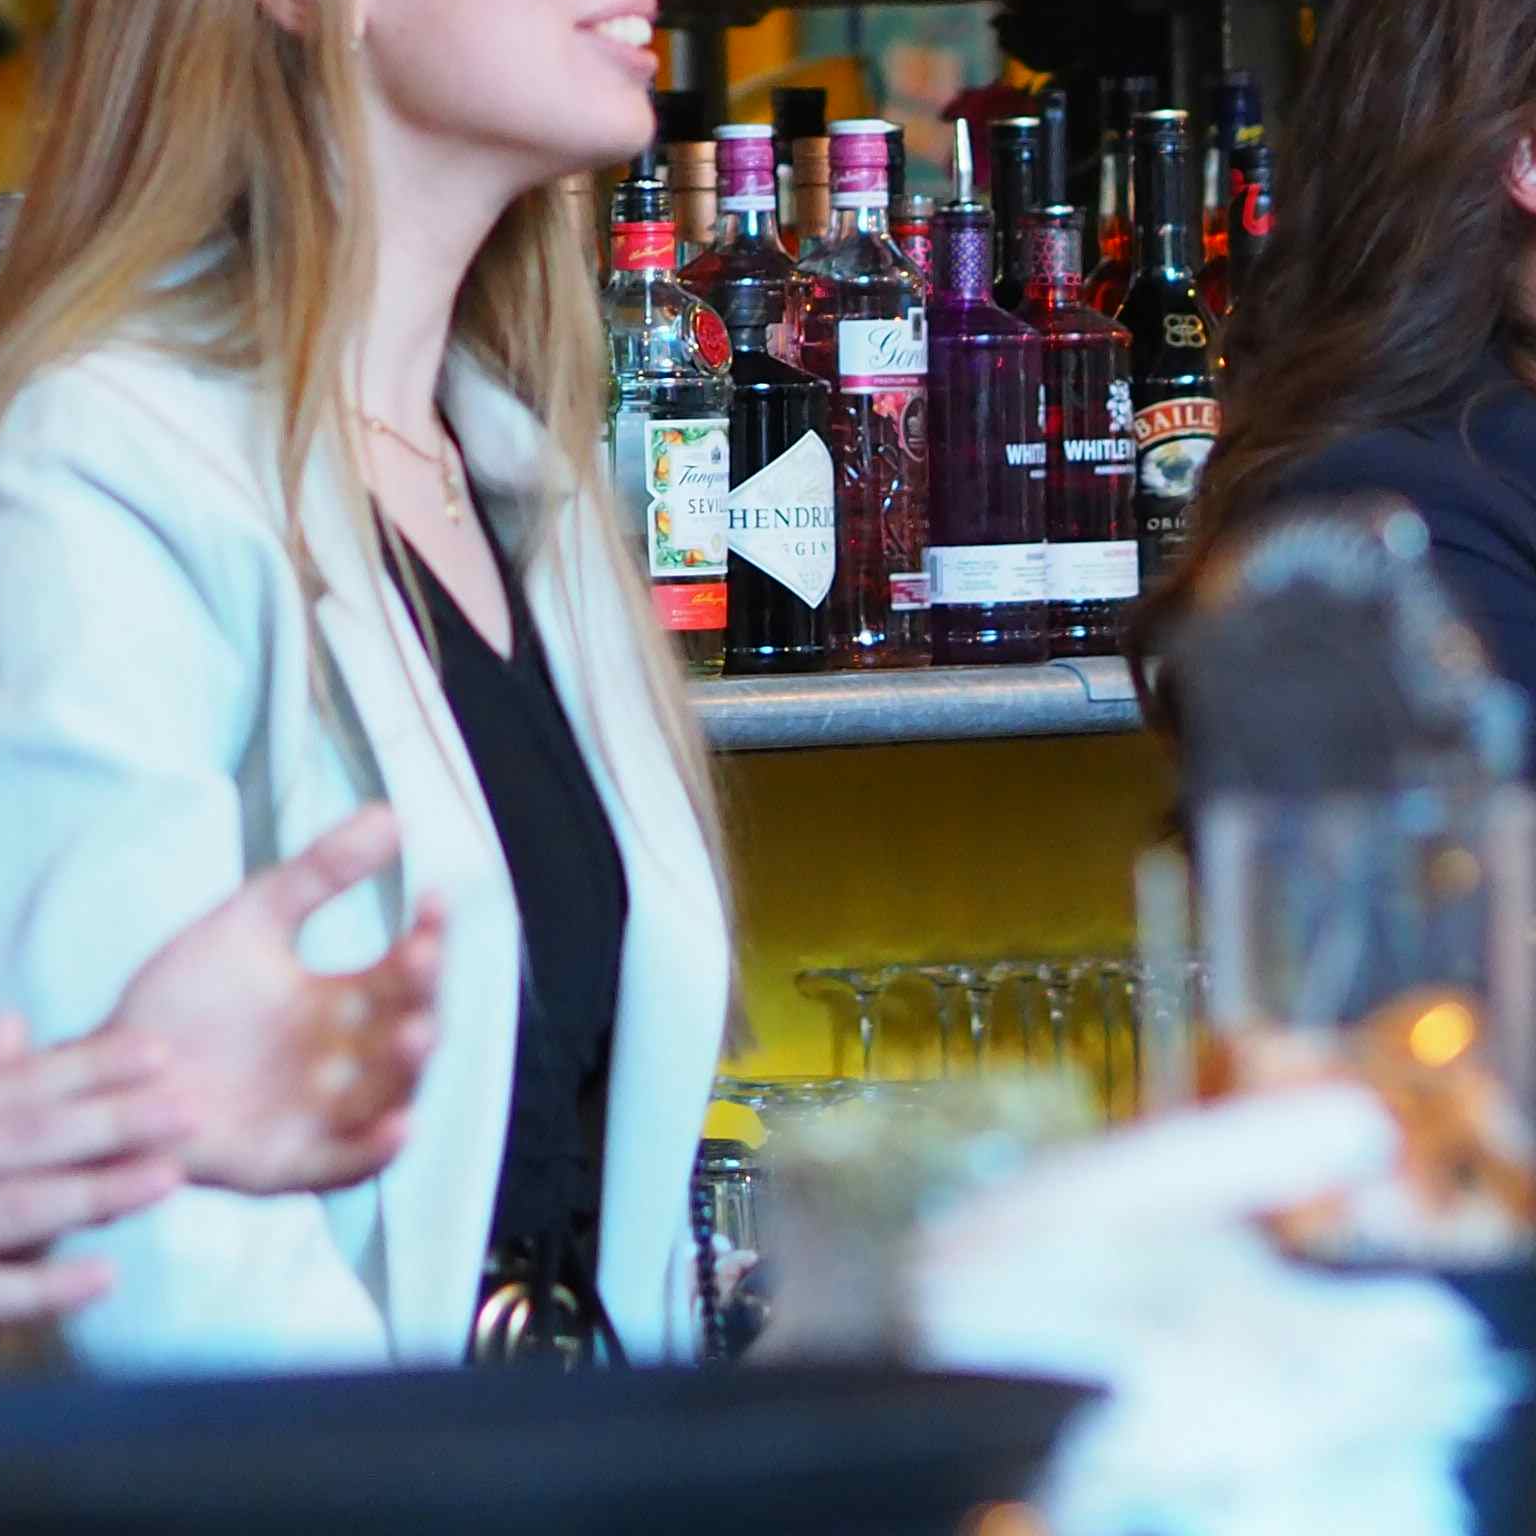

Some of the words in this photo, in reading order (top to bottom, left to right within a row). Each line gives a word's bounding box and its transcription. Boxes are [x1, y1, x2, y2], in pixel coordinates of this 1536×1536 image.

[1135, 404, 1214, 441] BAILE
[1006, 442, 1047, 465] WHIT
[1146, 517, 1186, 531] ORI
